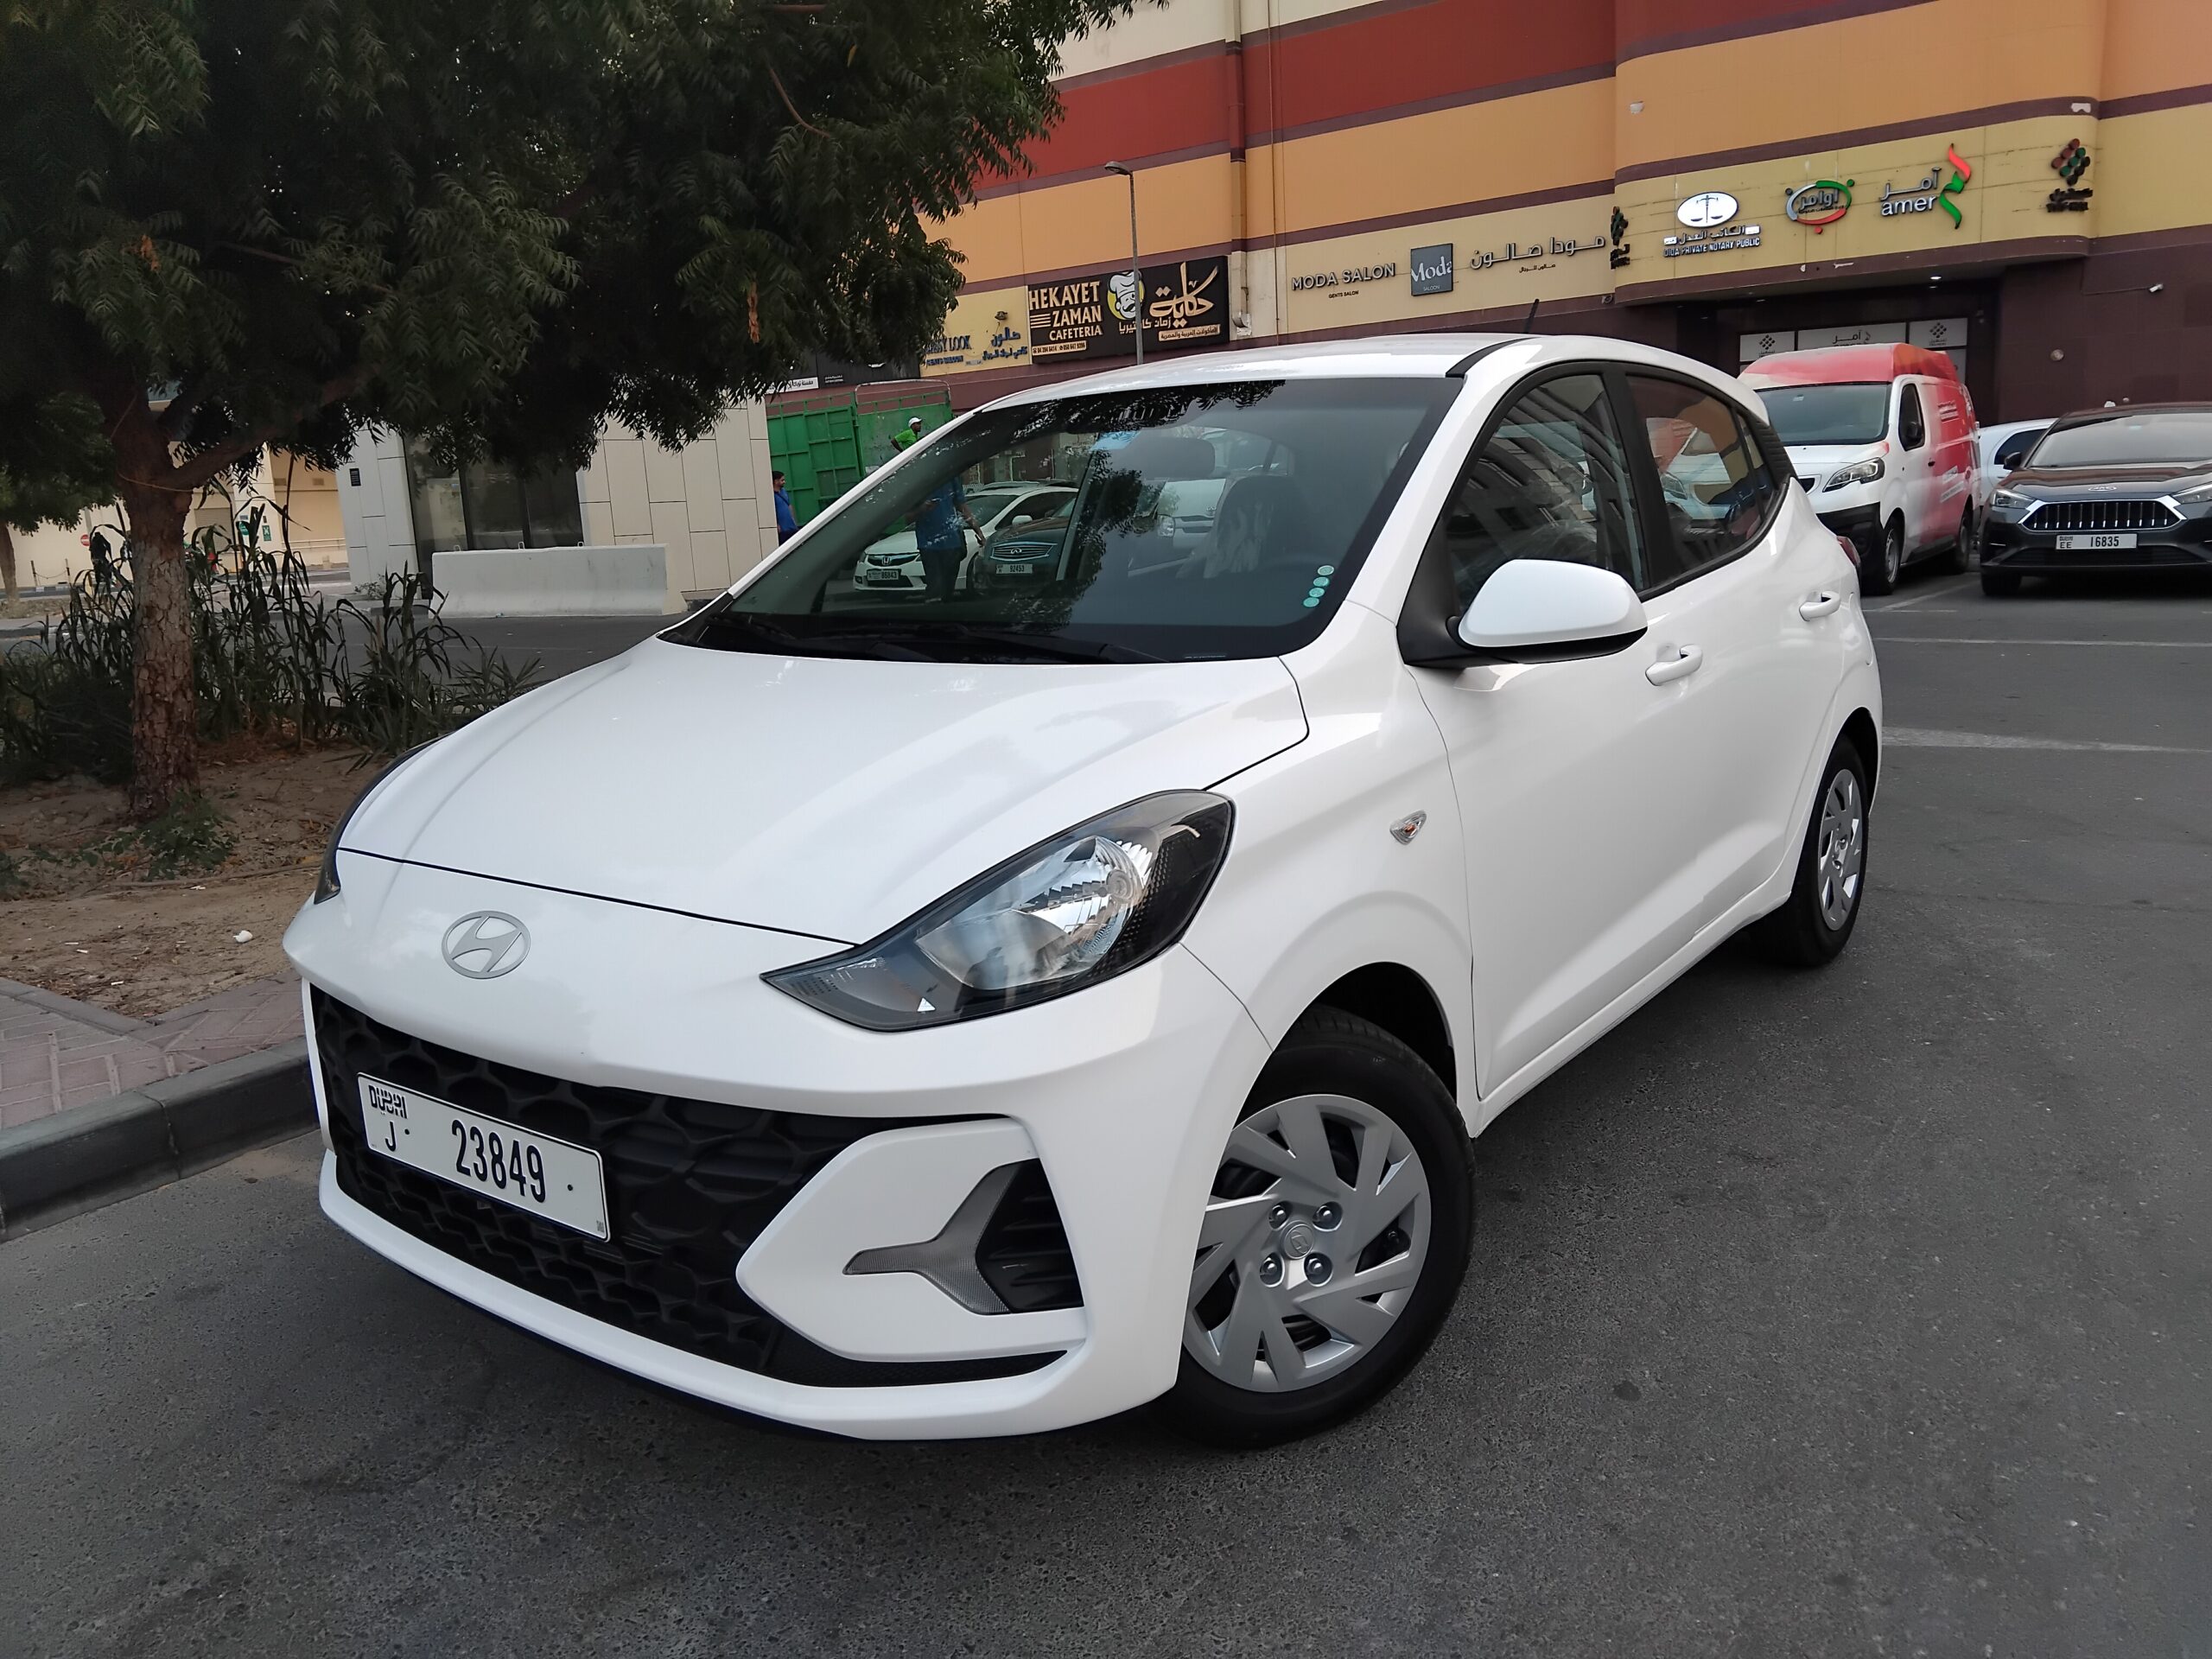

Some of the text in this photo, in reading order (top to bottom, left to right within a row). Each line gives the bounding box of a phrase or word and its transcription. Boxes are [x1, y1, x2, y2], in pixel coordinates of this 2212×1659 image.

[1880, 194, 1939, 217] amer
[1470, 241, 1542, 270] صالون
[1549, 235, 1605, 257] مودا
[1681, 244, 1707, 256] PRIVATE
[1709, 241, 1734, 252] NOTARY
[1737, 237, 1760, 248] PUBLIC
[1292, 263, 1396, 291] MODA SALON
[1410, 256, 1452, 282] Moda
[1028, 280, 1101, 311] HEKAYET
[1052, 305, 1103, 327] ZAMAN
[949, 334, 972, 352] LOOK
[1049, 324, 1103, 341] CAFETERIA
[2091, 536, 2120, 548] 16835
[385, 1119, 546, 1204] J 23849
